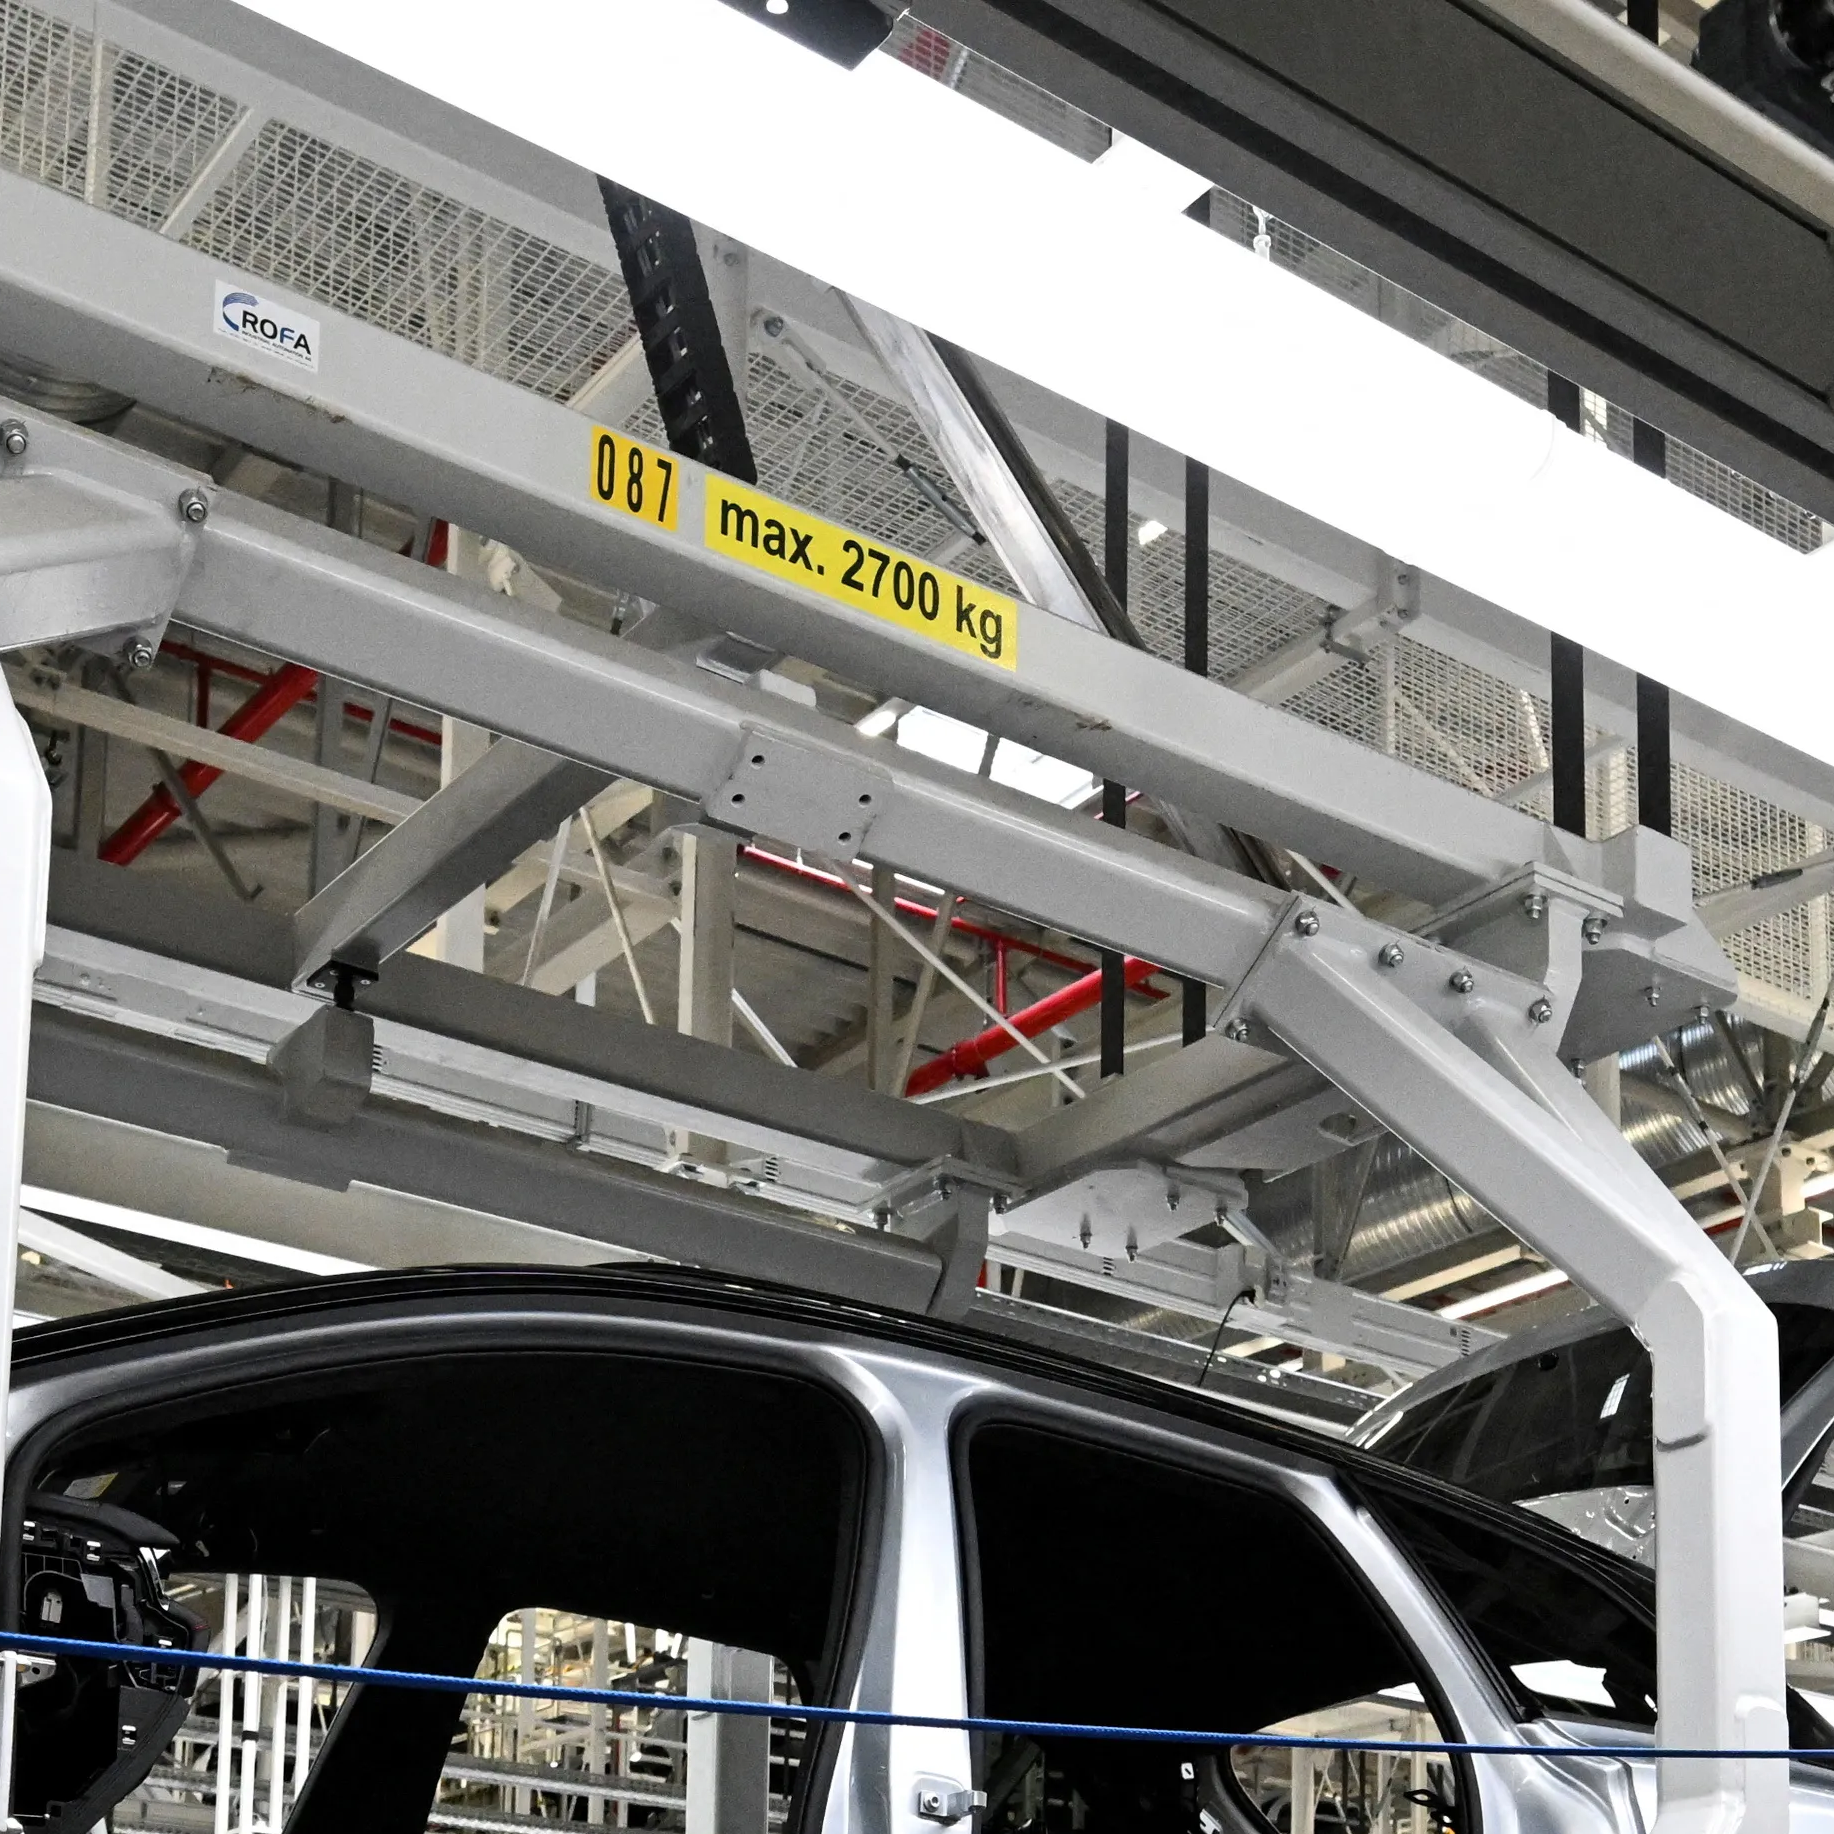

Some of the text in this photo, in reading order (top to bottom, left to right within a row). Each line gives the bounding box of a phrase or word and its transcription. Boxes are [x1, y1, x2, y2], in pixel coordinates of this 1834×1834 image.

[241, 309, 312, 356] ROFA
[596, 433, 673, 523] 087
[719, 497, 1003, 660] max. 2700 kg
